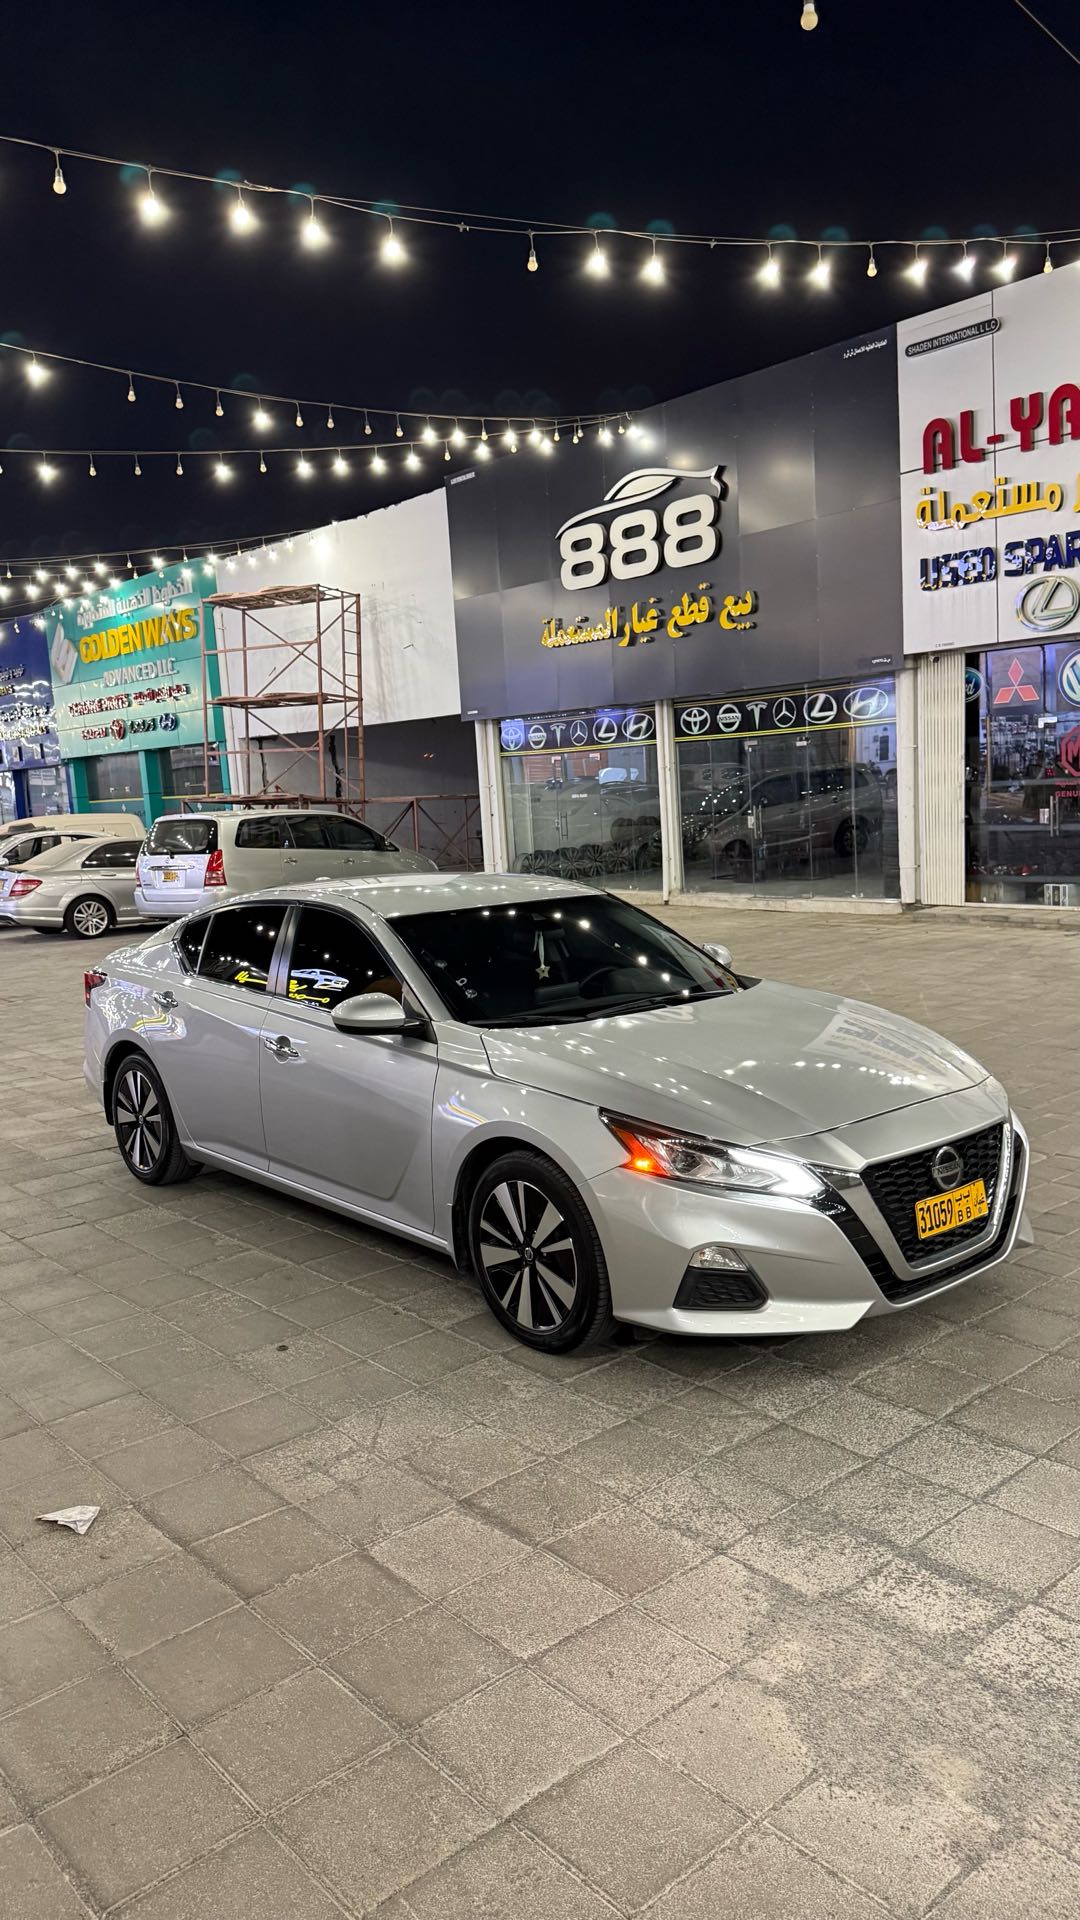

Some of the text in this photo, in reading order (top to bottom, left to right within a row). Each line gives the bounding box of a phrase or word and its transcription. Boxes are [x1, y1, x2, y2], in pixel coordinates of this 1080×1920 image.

[907, 341, 932, 355] SHADEN
[932, 326, 979, 348] INTERNATIONAL
[916, 478, 1062, 529] مستعملة
[559, 493, 718, 591] 888
[919, 546, 996, 591] USED
[617, 596, 661, 647] غيار
[666, 581, 711, 639] قطع
[719, 590, 755, 630] بيع
[79, 607, 197, 665] GOLDEN WAYS
[102, 661, 158, 688] ADVANCED
[718, 714, 741, 725] NISSAN
[918, 1198, 953, 1234] 31059
